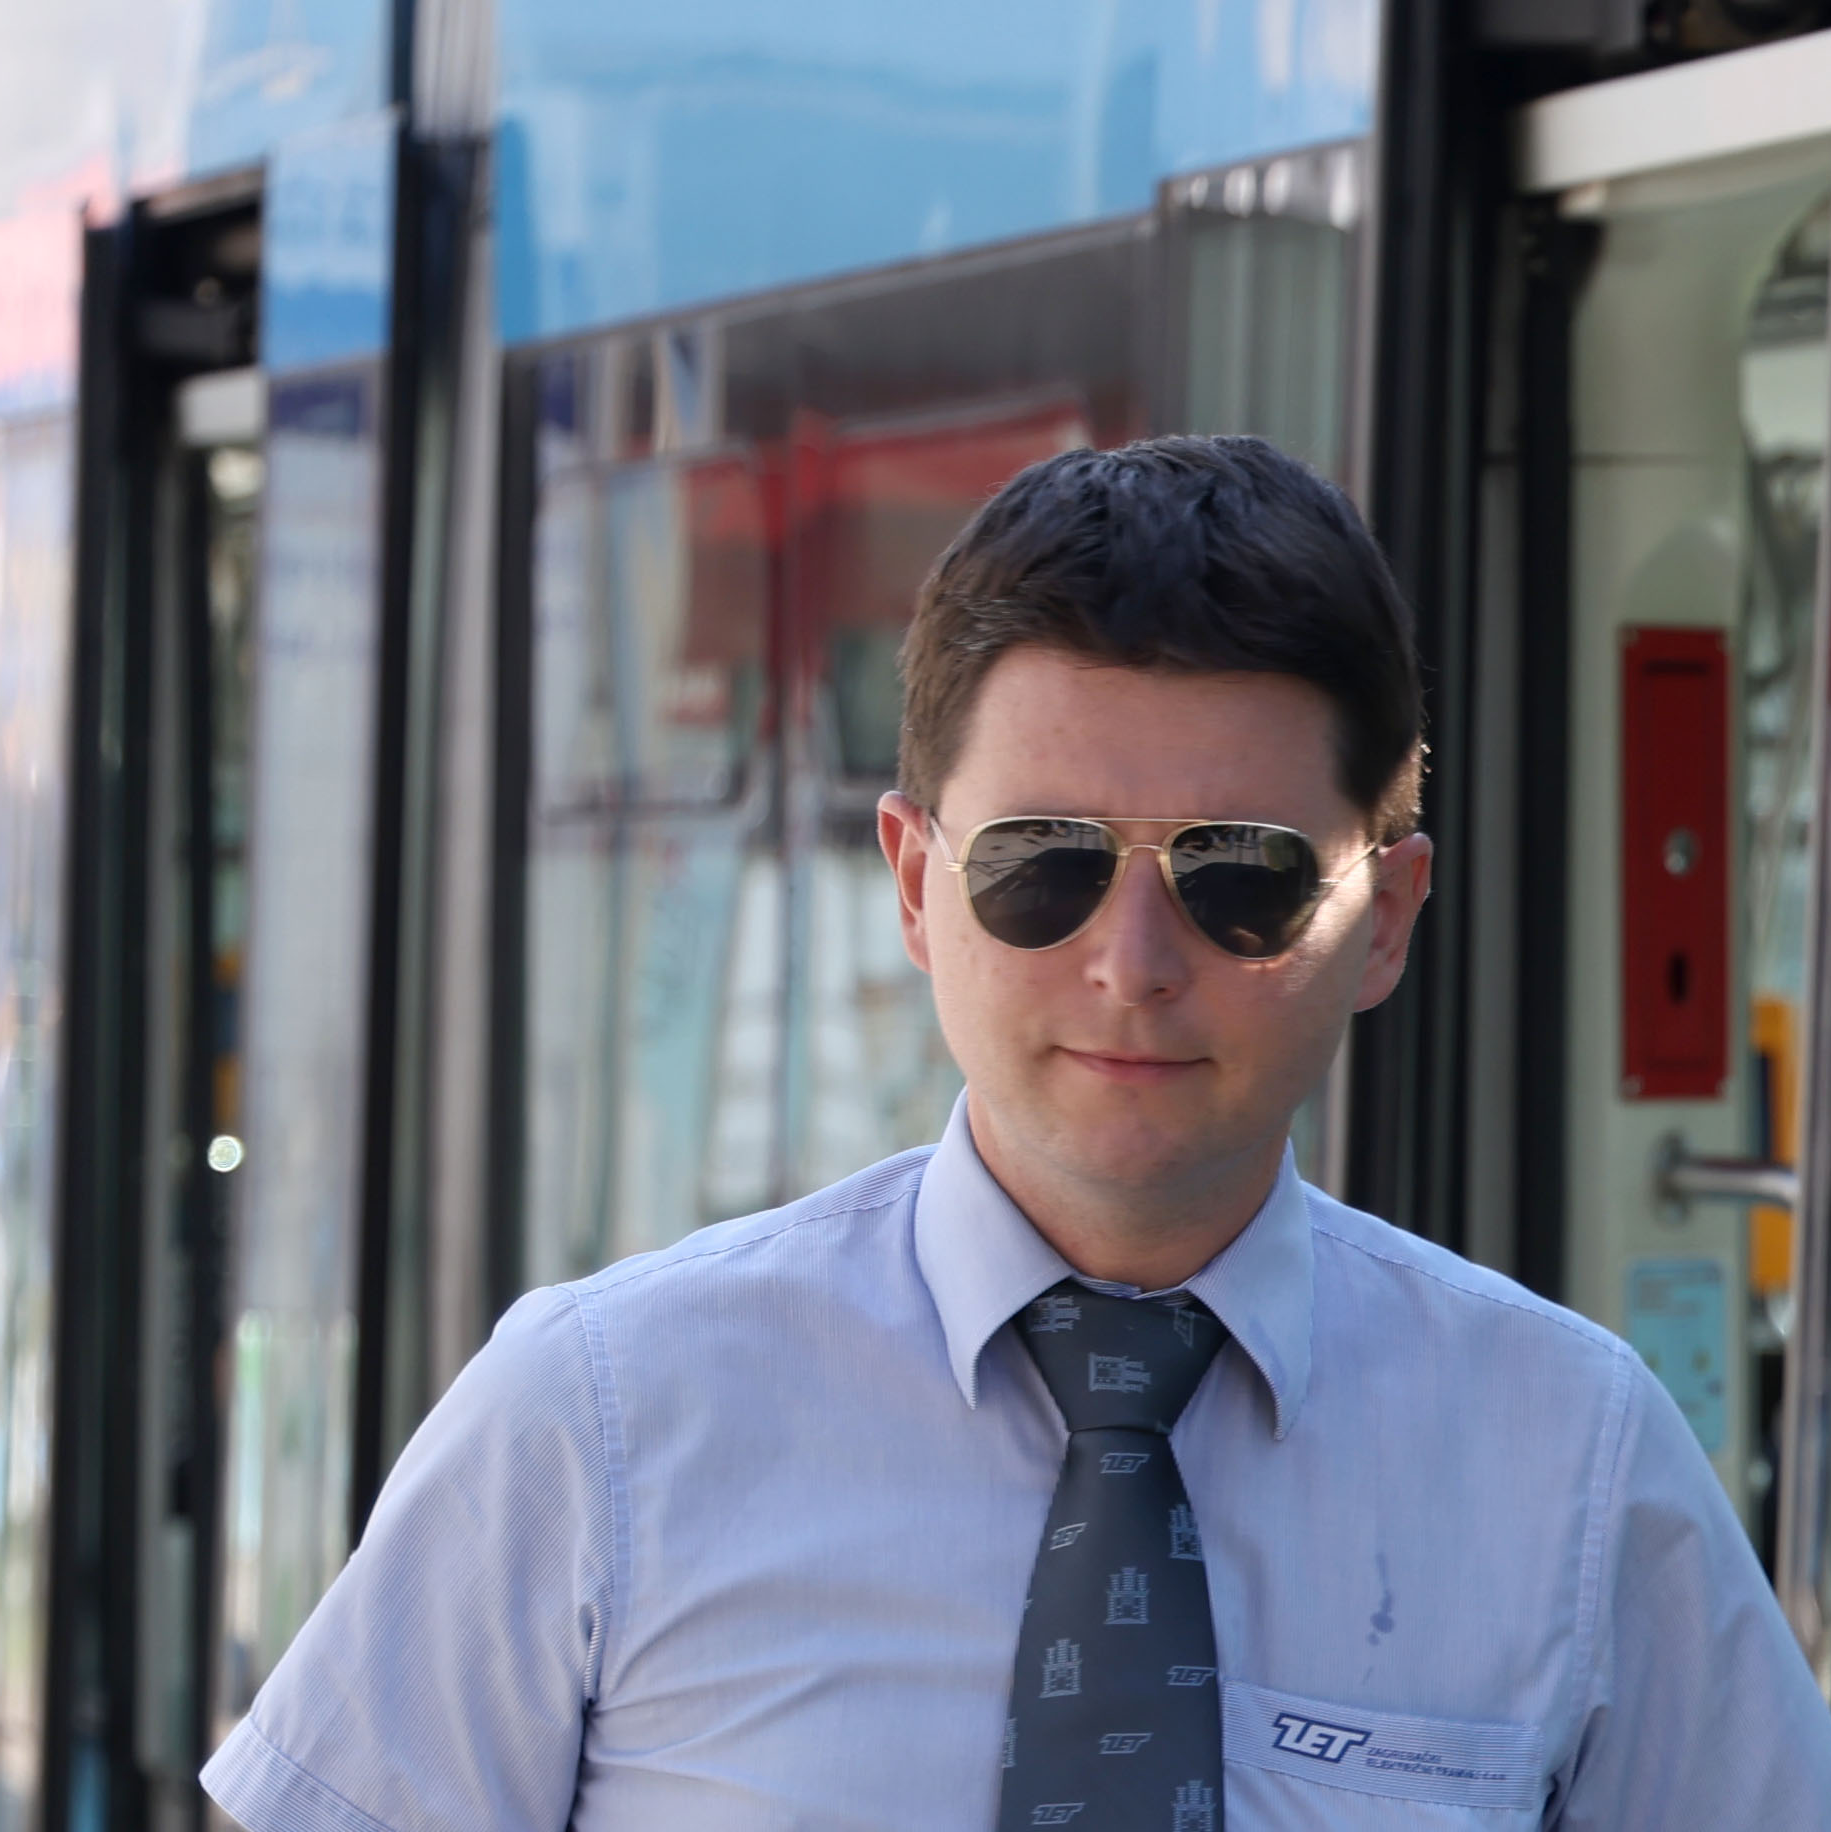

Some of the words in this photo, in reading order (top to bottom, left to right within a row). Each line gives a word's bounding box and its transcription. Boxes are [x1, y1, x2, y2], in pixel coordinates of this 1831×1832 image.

[1100, 1452, 1151, 1474] ZET
[1166, 1665, 1218, 1686] ZET
[1099, 1733, 1154, 1755] ZET
[1273, 1712, 1372, 1763] ZET
[1031, 1802, 1086, 1825] ZET
